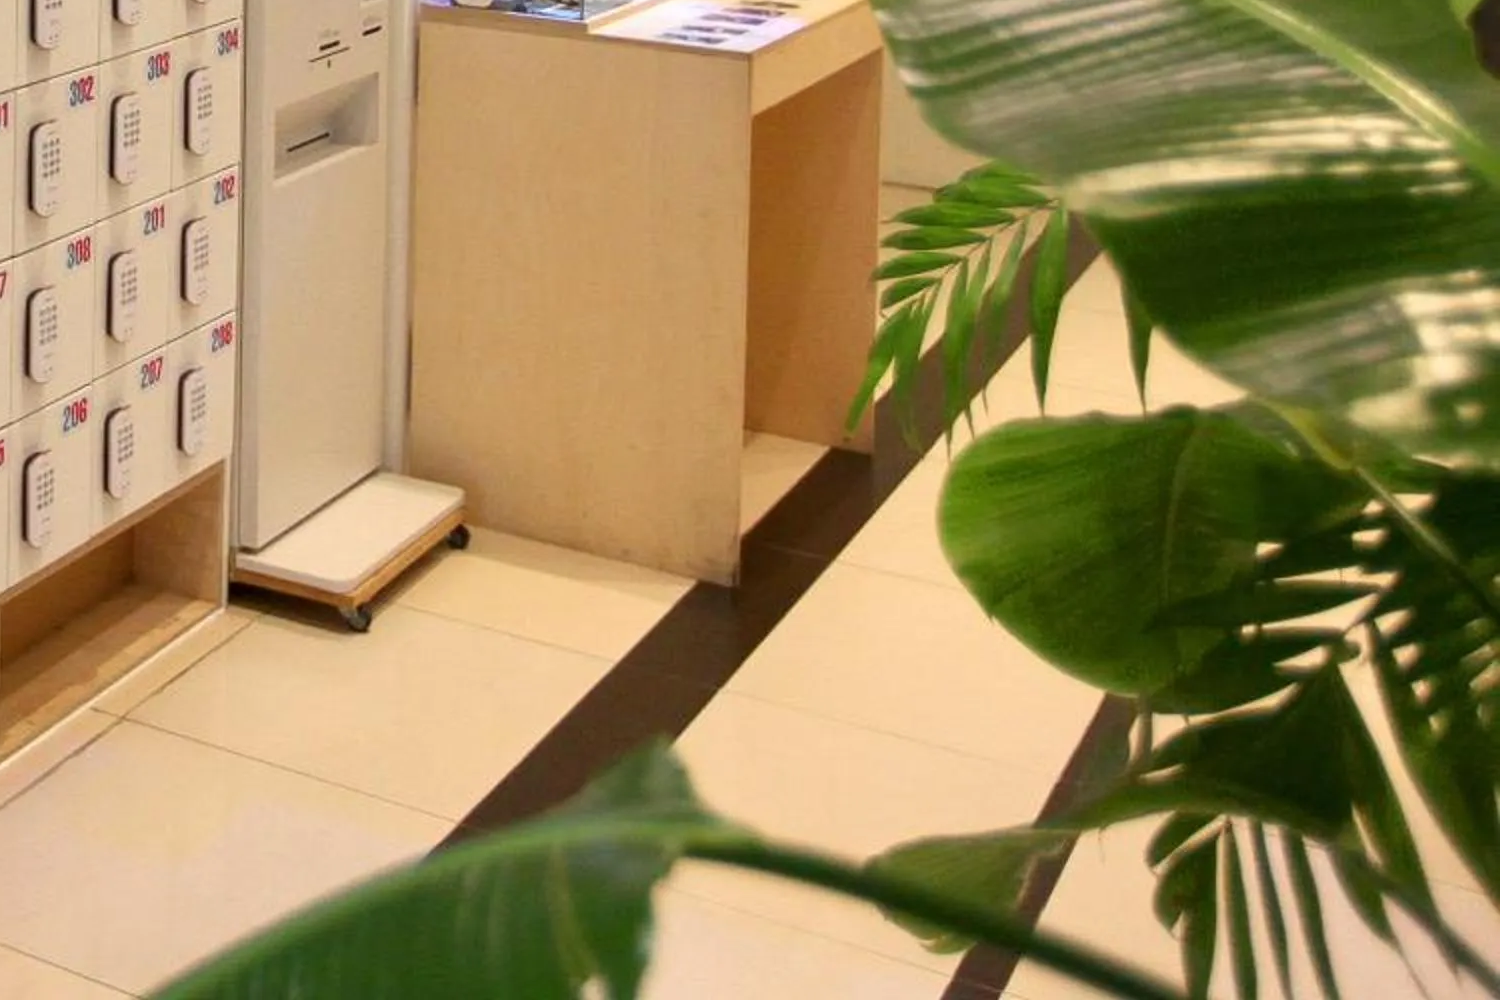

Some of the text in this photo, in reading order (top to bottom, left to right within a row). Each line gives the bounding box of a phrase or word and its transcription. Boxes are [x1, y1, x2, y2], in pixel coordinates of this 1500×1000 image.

[218, 27, 239, 55] 304
[147, 52, 170, 81] 303
[68, 76, 94, 107] 302
[213, 175, 236, 204] 202
[143, 204, 165, 234] 201
[67, 236, 91, 270] 308
[211, 321, 233, 352] 208
[141, 356, 163, 389] 207
[62, 398, 88, 432] 206
